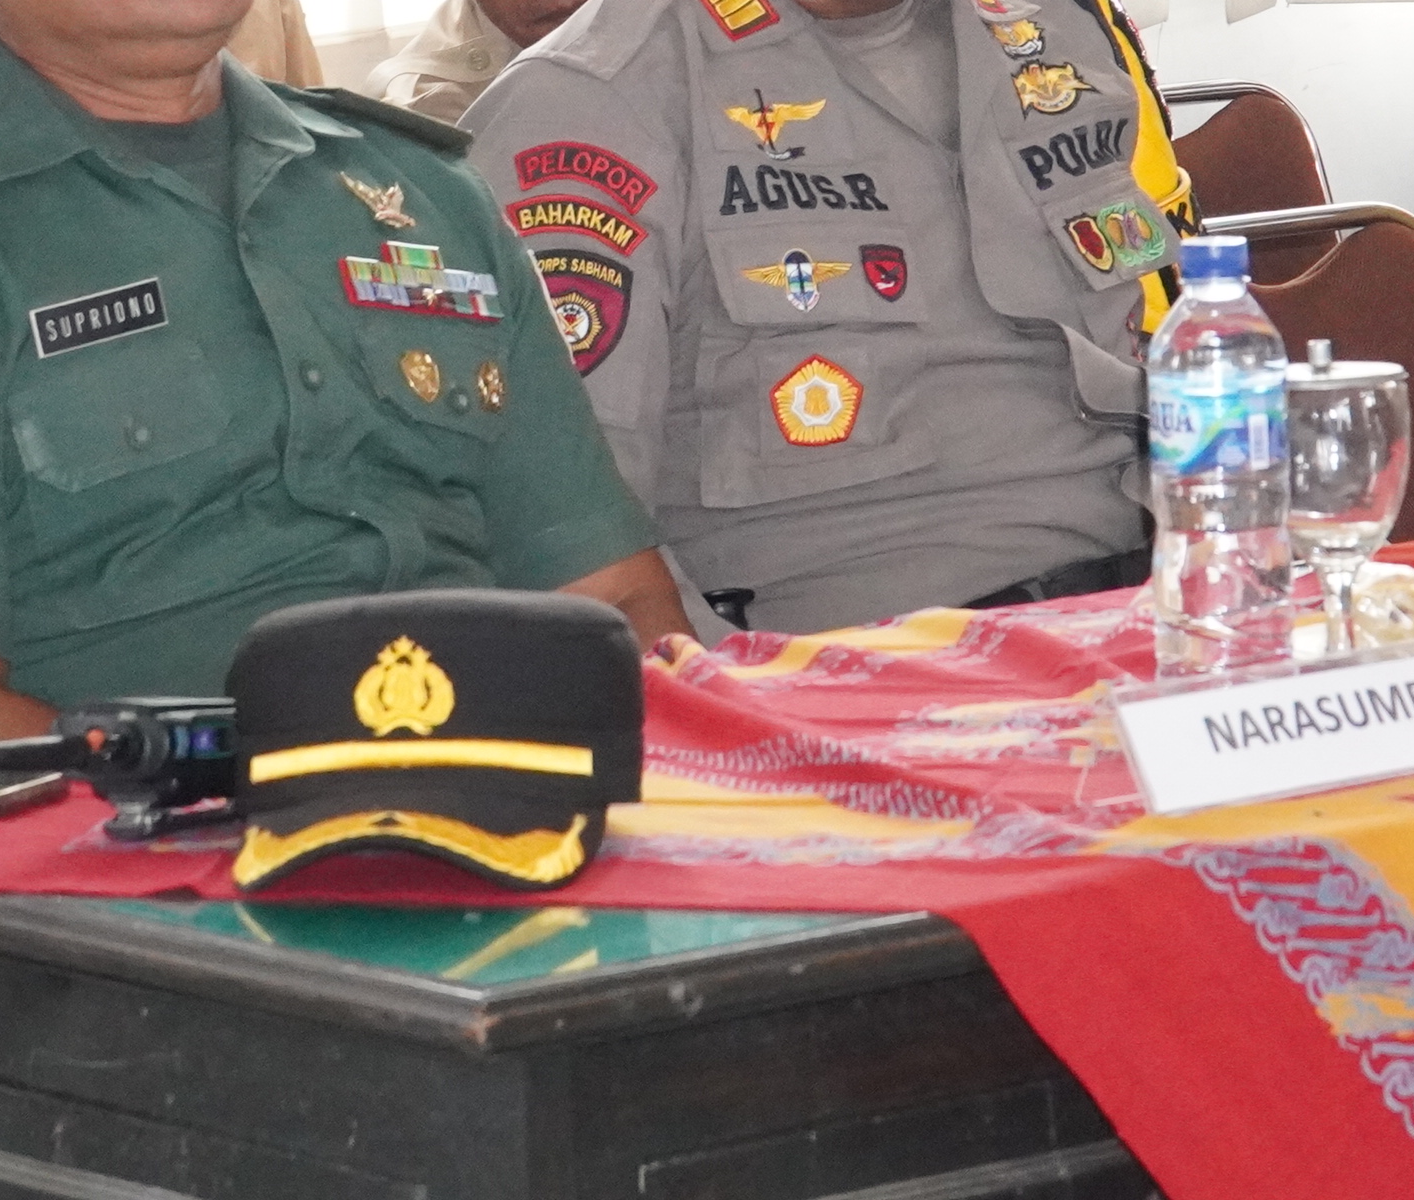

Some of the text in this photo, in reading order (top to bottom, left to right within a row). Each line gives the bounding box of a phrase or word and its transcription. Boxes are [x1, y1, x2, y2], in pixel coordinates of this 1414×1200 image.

[524, 150, 644, 205] PELOPOR
[1019, 118, 1128, 190] POLRI
[518, 202, 635, 248] BAHARKAM
[536, 257, 624, 288] ORPS SABHARA
[45, 292, 156, 342] SUPRIONO
[1149, 401, 1196, 438] QUA
